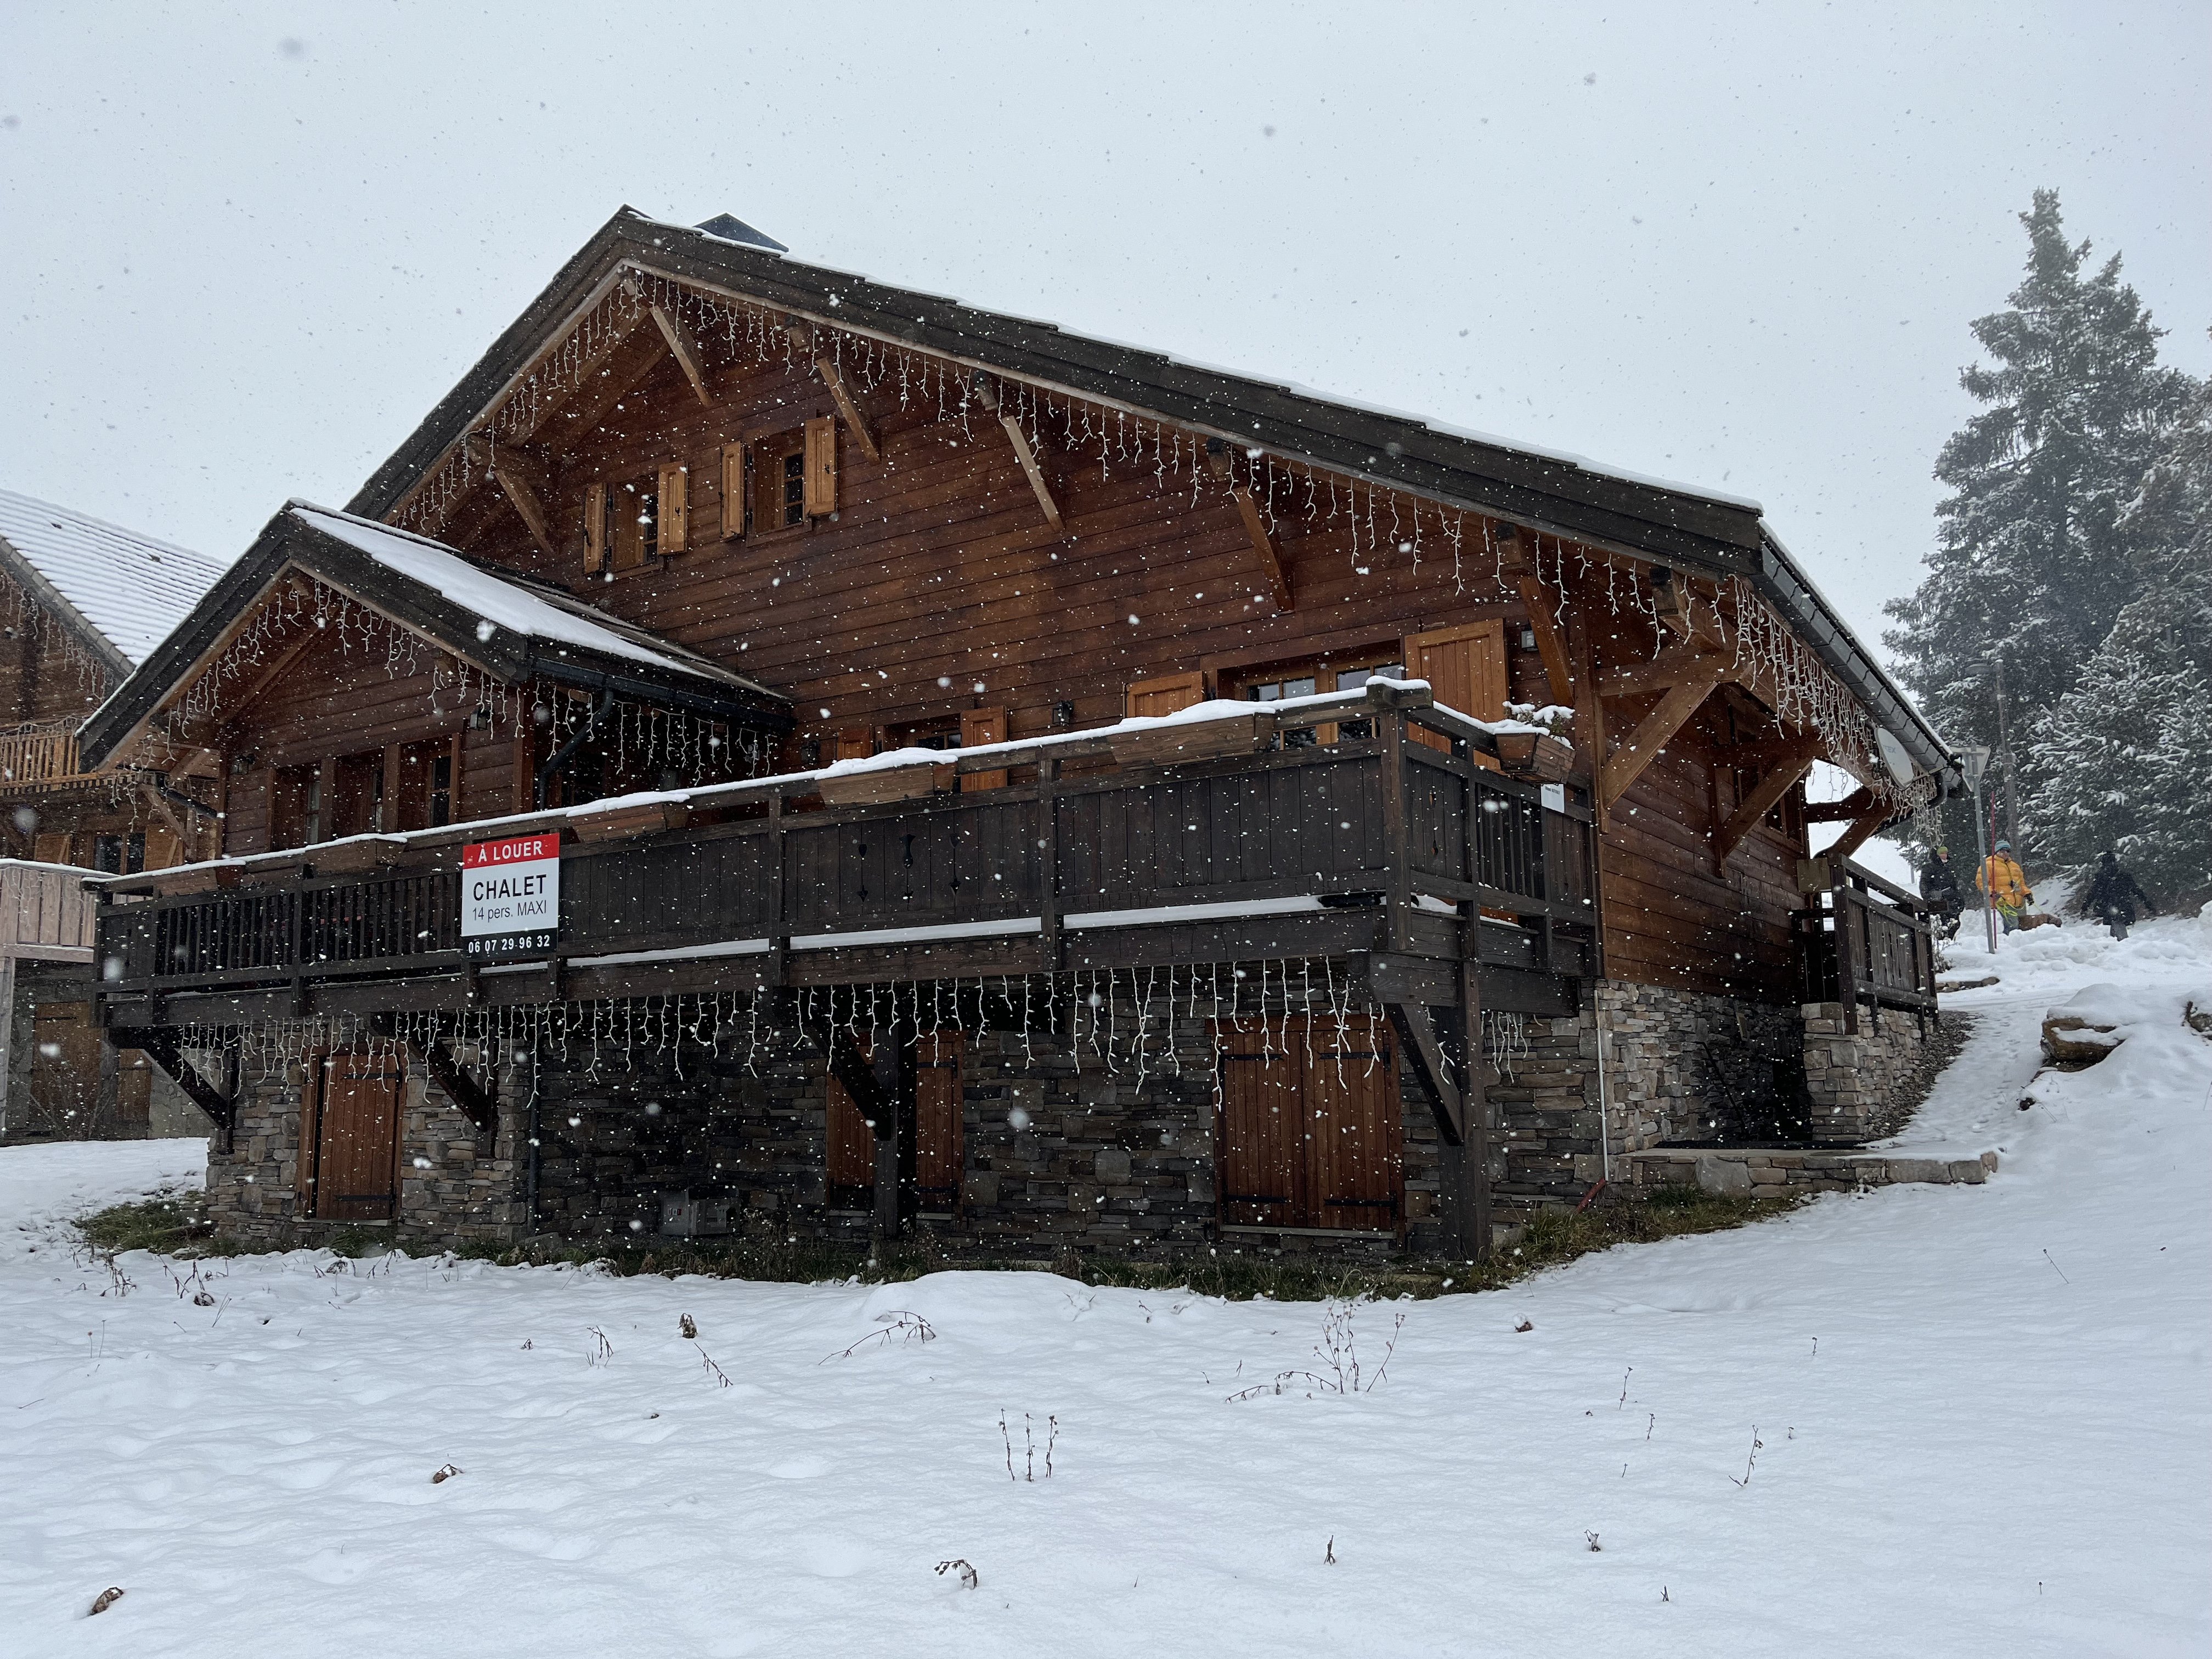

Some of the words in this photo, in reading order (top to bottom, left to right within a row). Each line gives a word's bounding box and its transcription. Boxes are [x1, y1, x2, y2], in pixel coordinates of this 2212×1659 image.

[478, 844, 487, 862] À
[493, 840, 542, 861] LOUER
[473, 874, 546, 901] CHALET
[472, 906, 484, 921] 14
[488, 907, 513, 923] pers.
[517, 900, 546, 916] MAXI
[468, 941, 481, 953] 06
[484, 940, 497, 951] 07
[501, 938, 514, 950] 29
[519, 936, 532, 949] 96
[537, 935, 550, 947] 32
